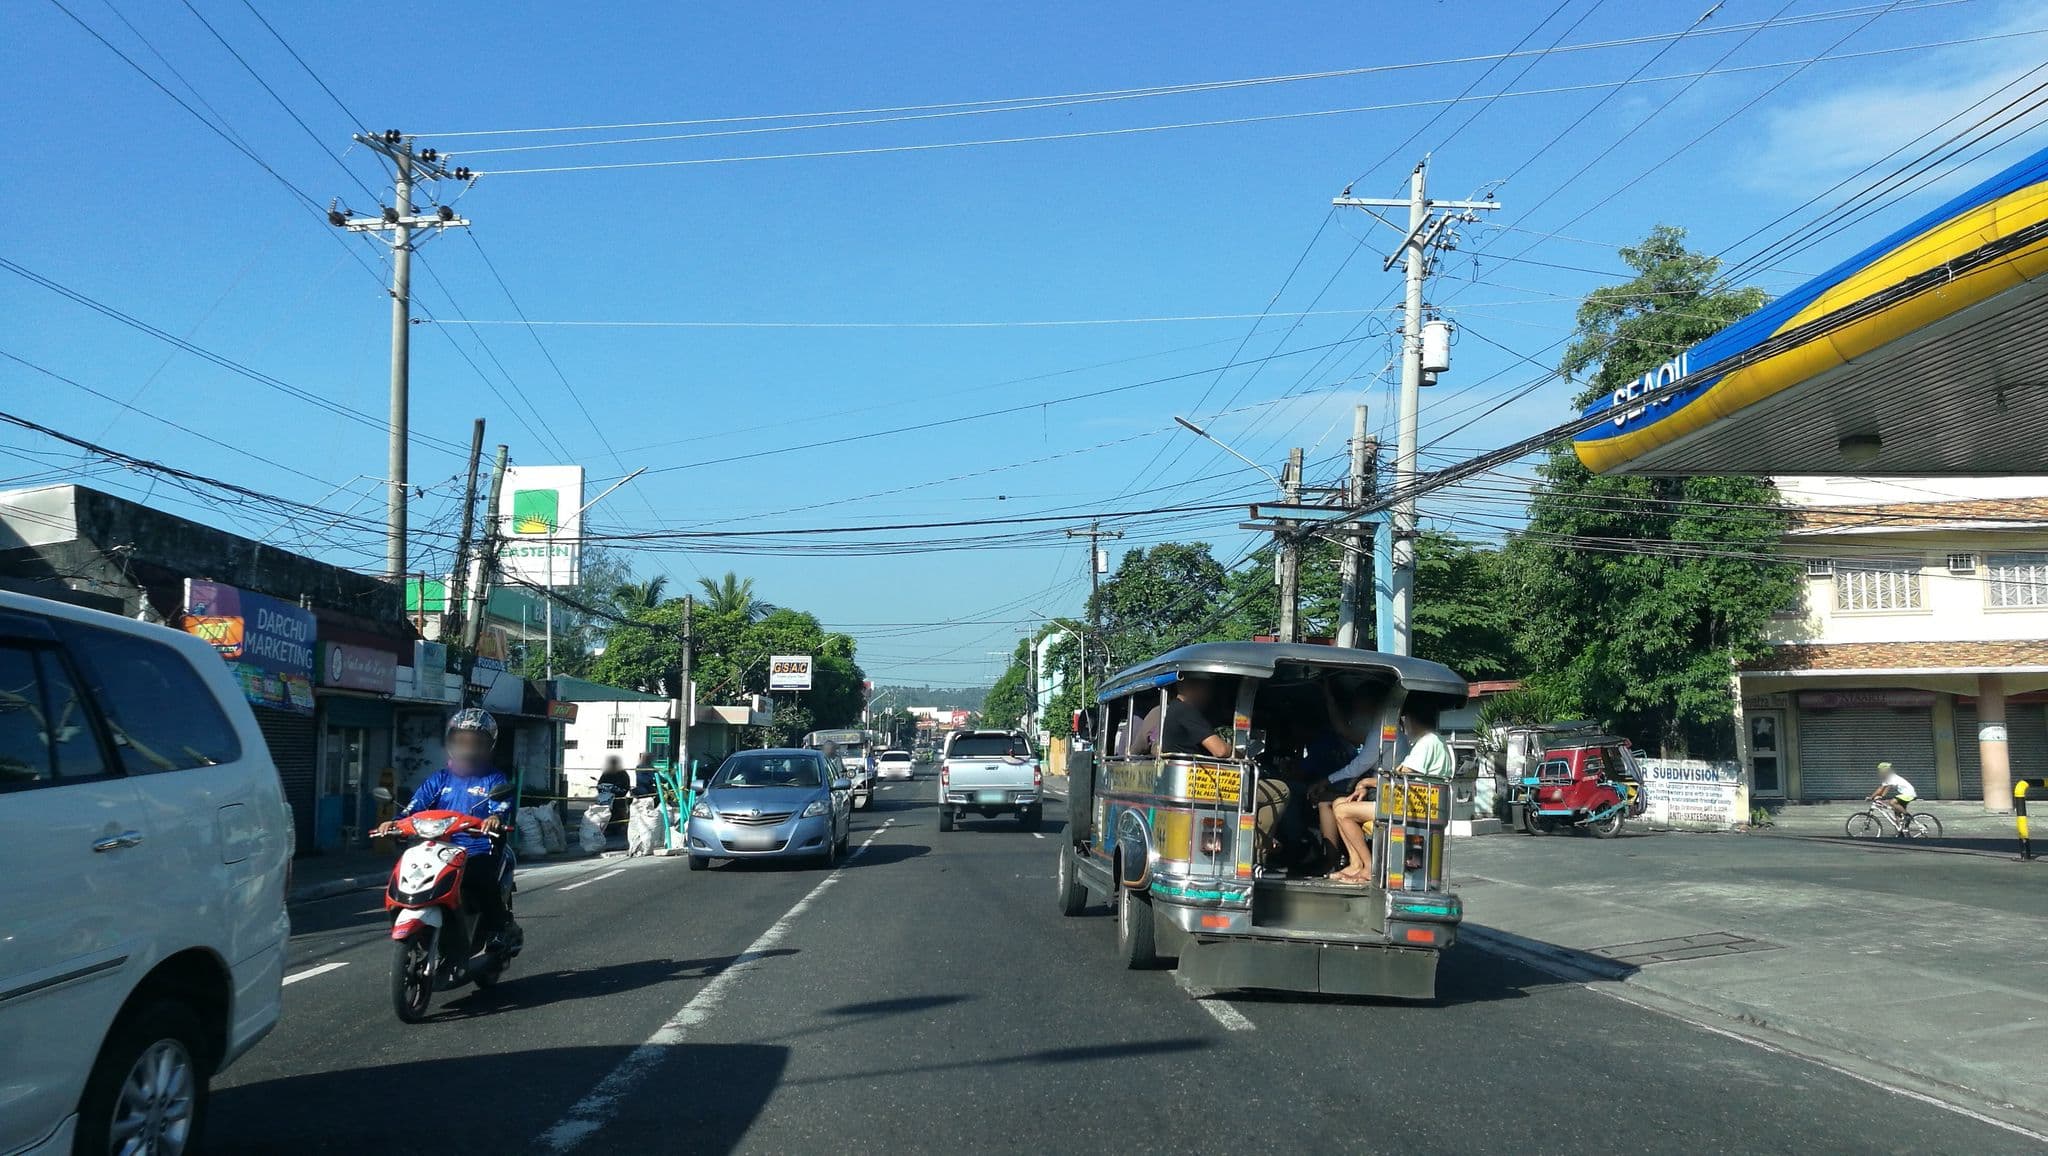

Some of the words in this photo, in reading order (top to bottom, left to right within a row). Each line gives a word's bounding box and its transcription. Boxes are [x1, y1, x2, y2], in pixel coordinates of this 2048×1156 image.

[500, 546, 569, 557] EASTERN
[257, 607, 307, 642] DARCHU
[244, 631, 313, 669] MARKETING
[774, 662, 807, 673] GSAC
[1653, 767, 1719, 781] SUBDIVISION
